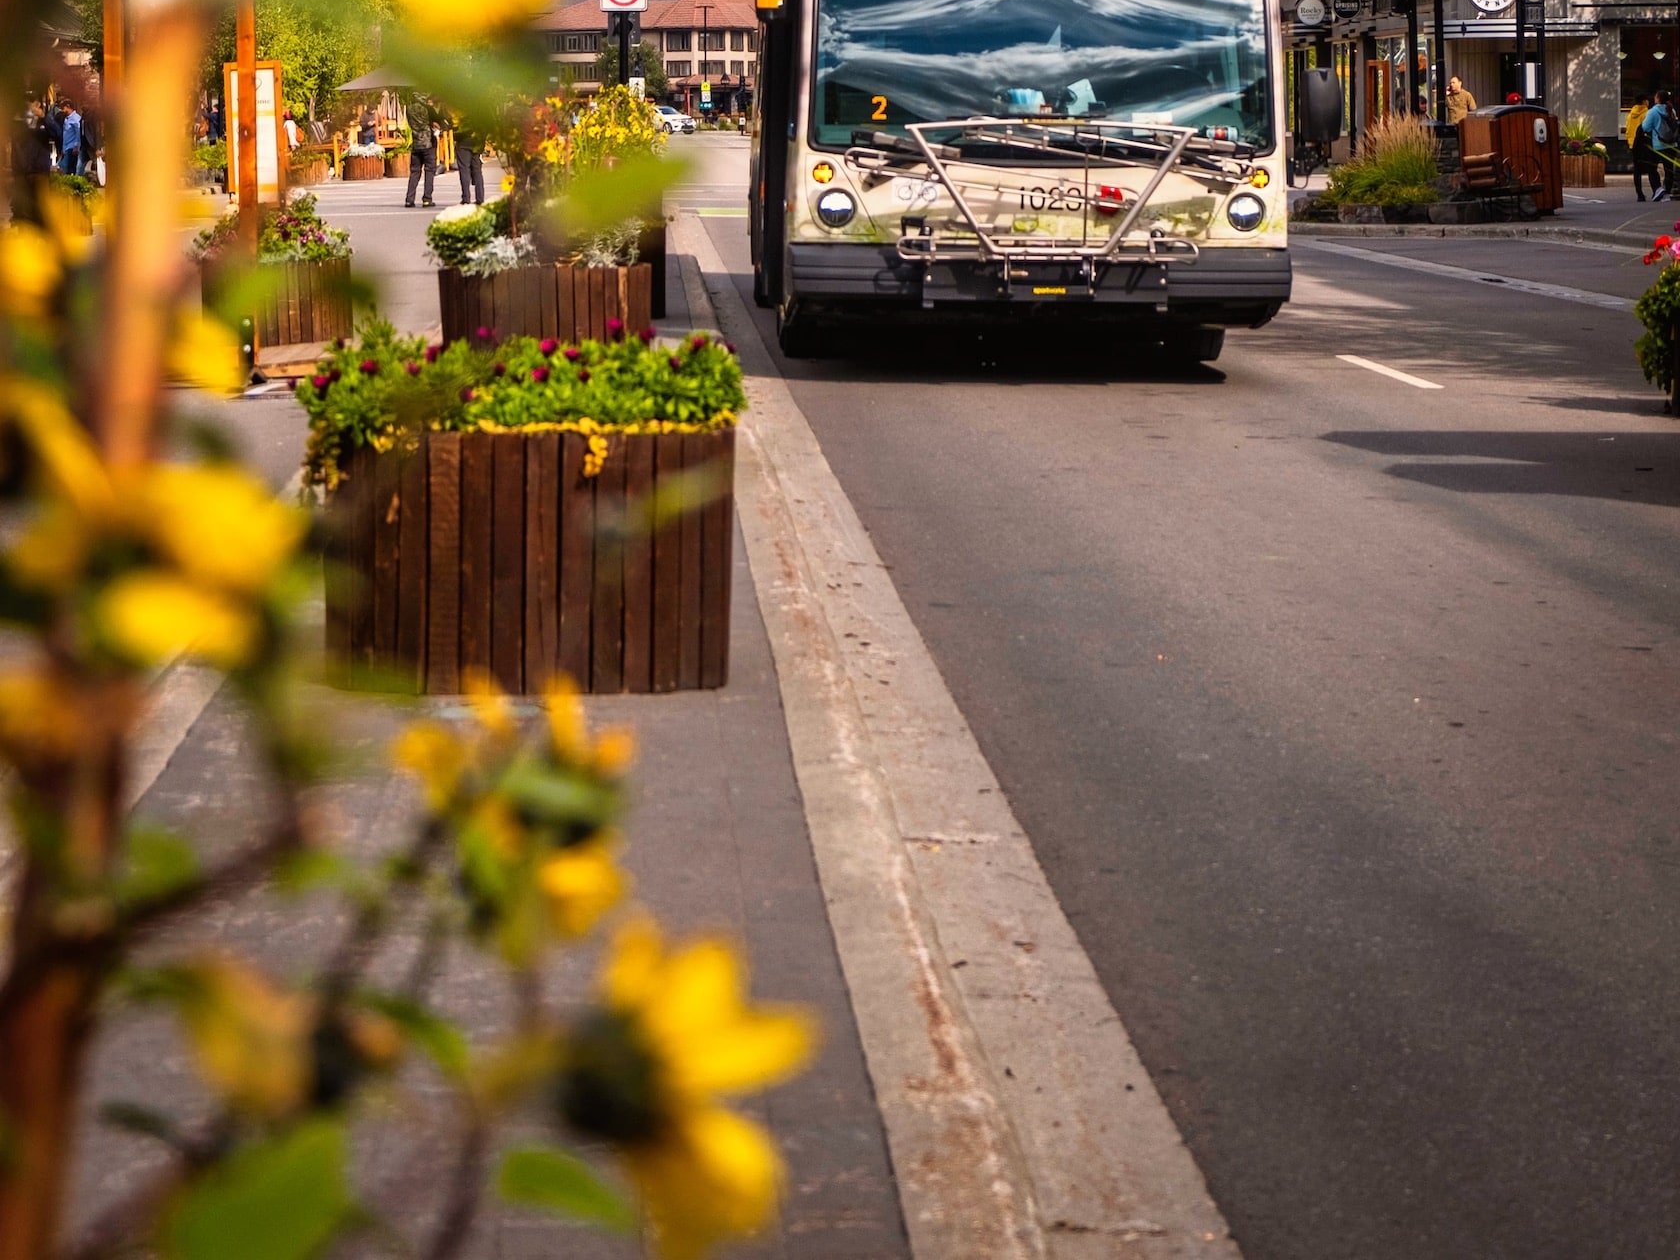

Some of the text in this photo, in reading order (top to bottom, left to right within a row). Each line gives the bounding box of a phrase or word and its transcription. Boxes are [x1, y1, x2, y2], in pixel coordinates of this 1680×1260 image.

[1300, 6, 1323, 15] Rocky
[871, 95, 887, 120] 2
[1020, 186, 1082, 211] 1023
